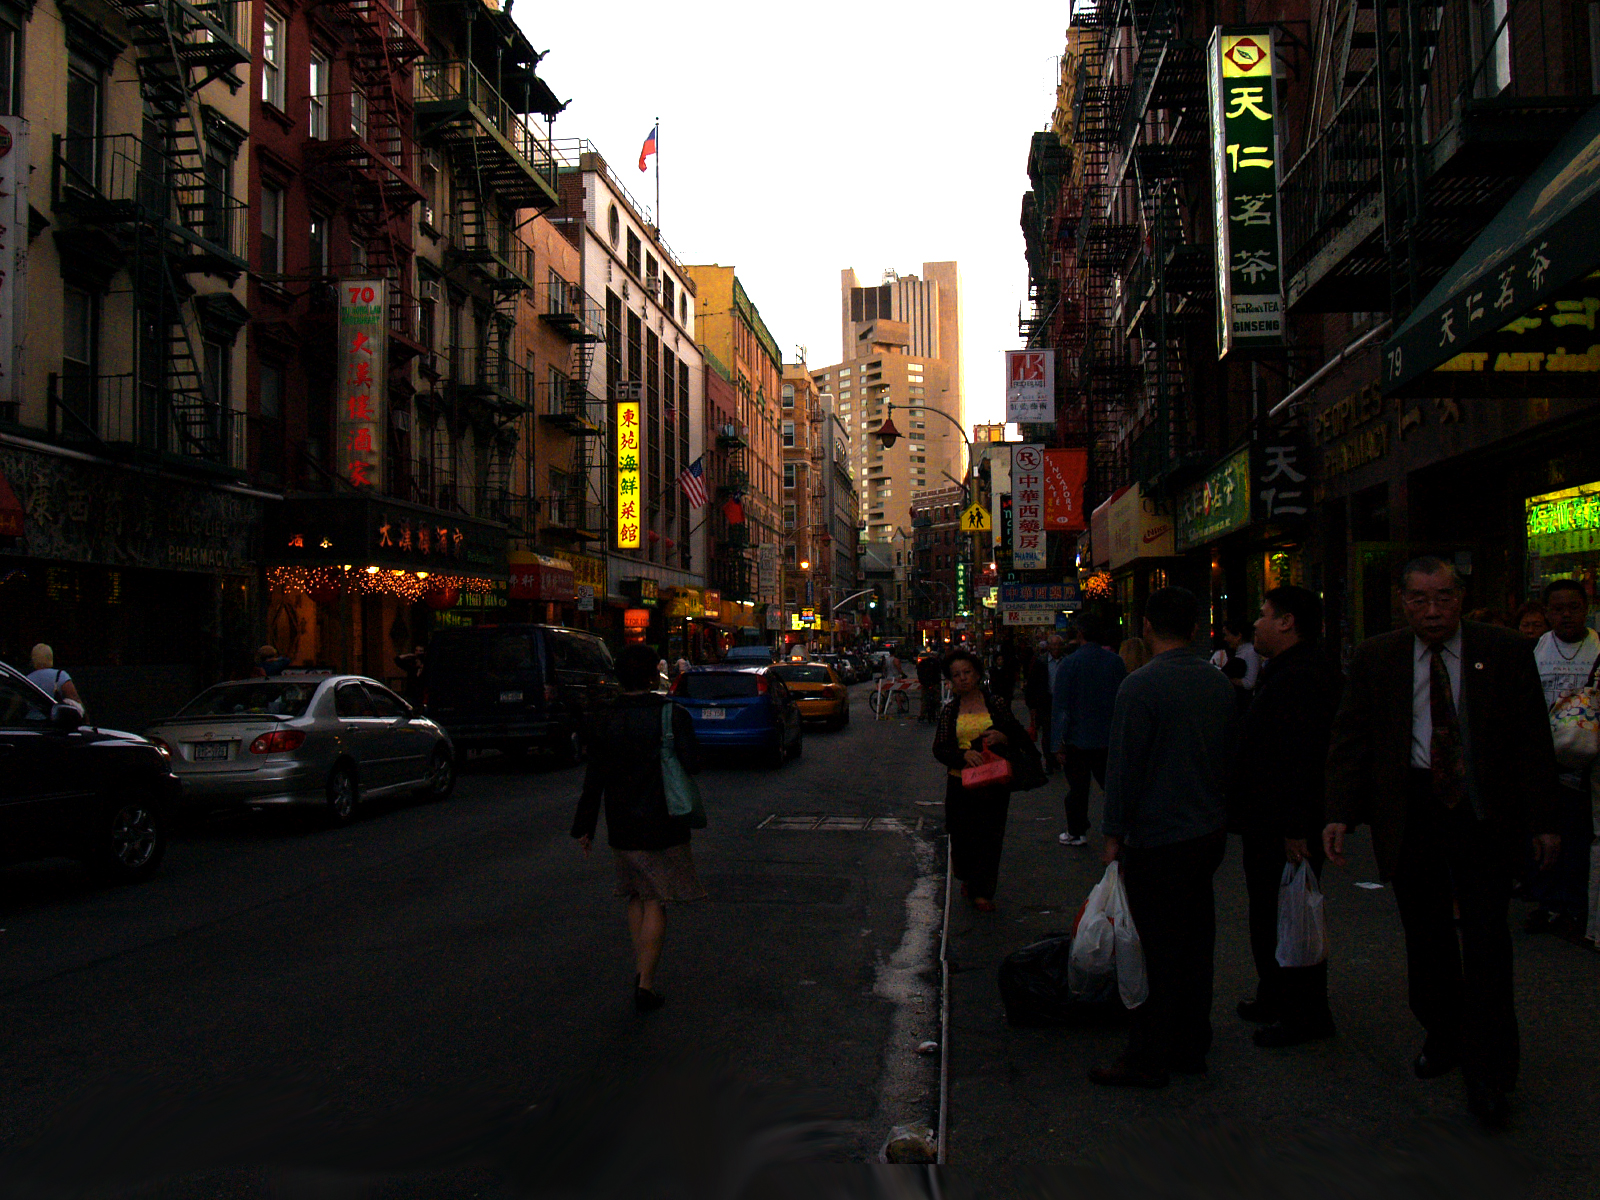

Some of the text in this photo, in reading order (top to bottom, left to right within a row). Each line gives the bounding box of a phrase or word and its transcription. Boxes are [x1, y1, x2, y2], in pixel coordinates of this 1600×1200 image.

[1225, 87, 1277, 284] 天仁茗茶
[348, 287, 374, 304] 70
[1263, 301, 1279, 312] TEA
[1439, 241, 1551, 348] 天仁茗茶
[1232, 320, 1279, 332] GINSENG
[1388, 346, 1403, 381] 79
[1045, 455, 1072, 511] SINGAPORE
[1259, 445, 1308, 520] 天仁
[1018, 473, 1040, 549] 中華西藥房
[168, 545, 229, 568] PHARMACY
[1014, 551, 1044, 562] PHARMAY
[1045, 602, 1078, 610] PHARMACY
